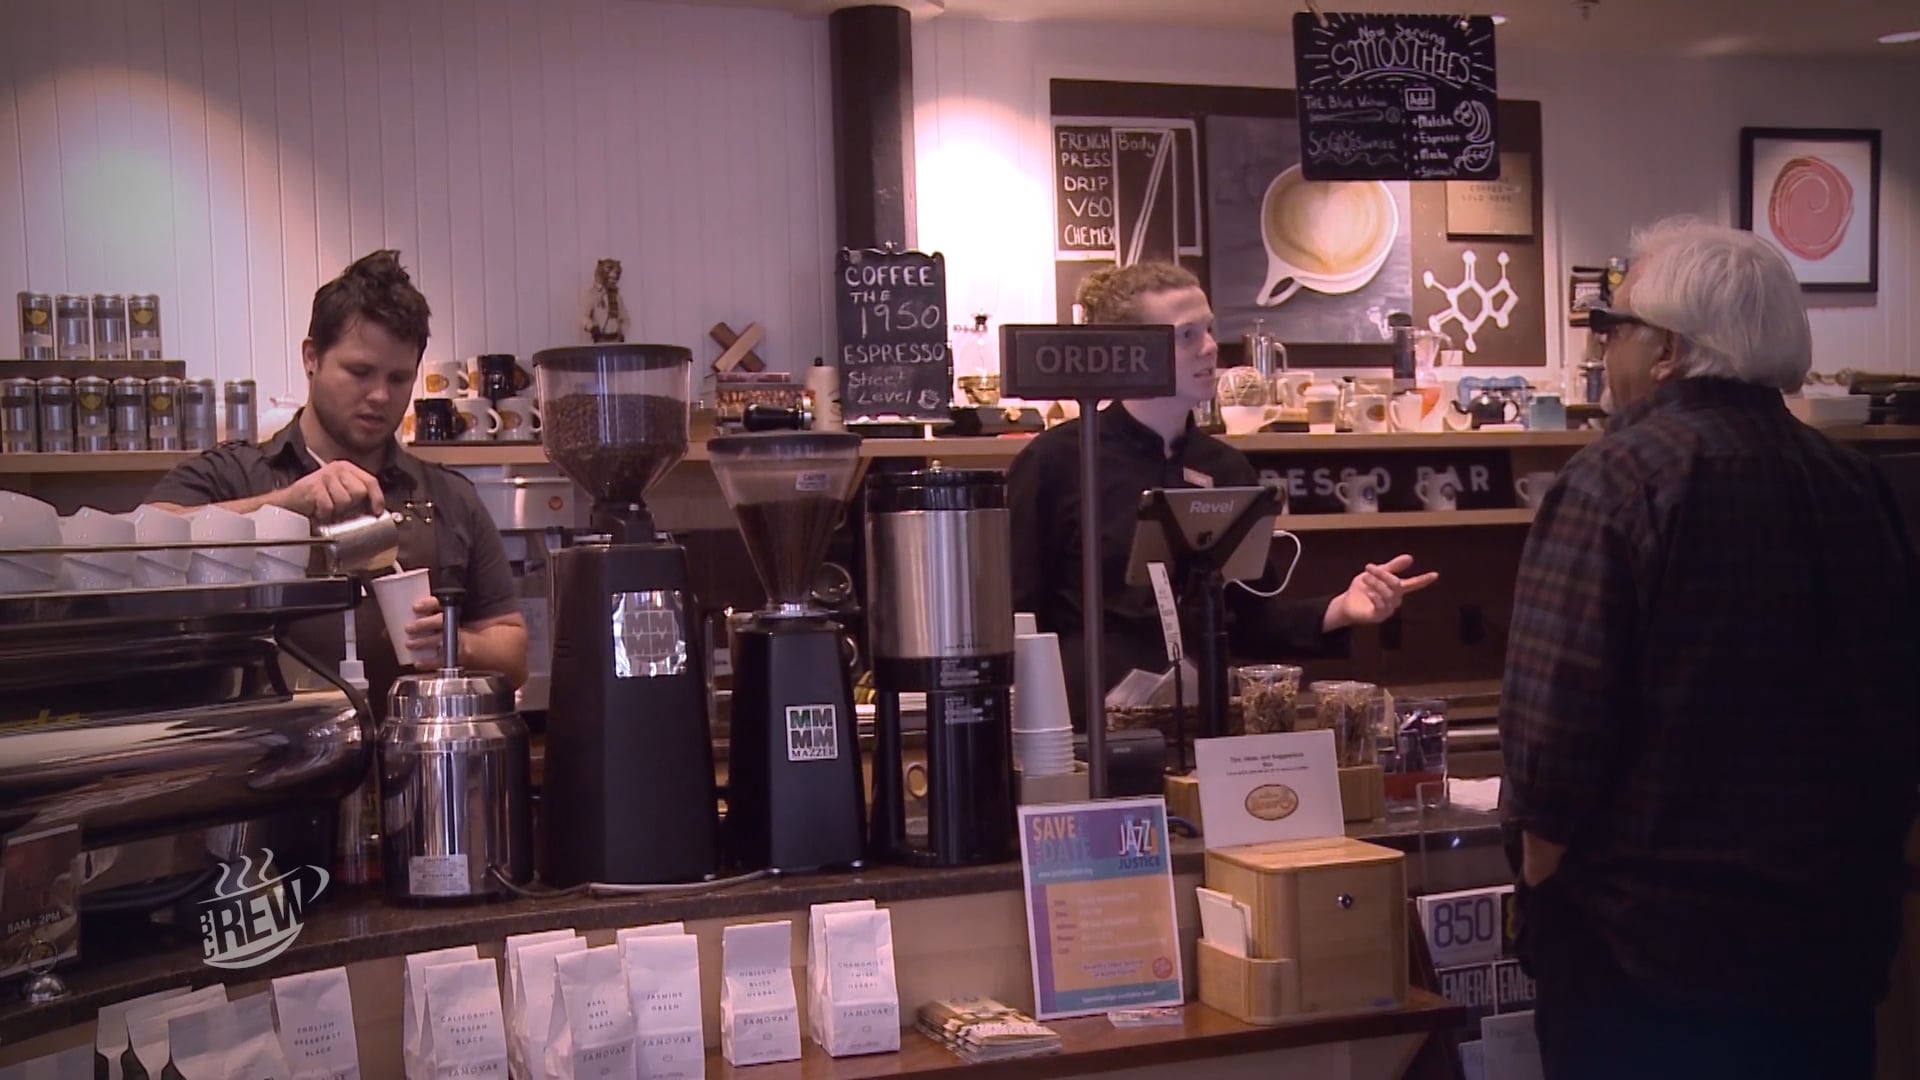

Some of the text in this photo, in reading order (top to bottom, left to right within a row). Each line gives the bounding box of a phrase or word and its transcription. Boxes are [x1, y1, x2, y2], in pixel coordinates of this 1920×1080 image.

[1358, 23, 1446, 48] Now Serving
[1331, 36, 1471, 83] SMOOTHIES
[1060, 131, 1111, 150] FRENCH
[1117, 134, 1157, 158] Body
[1061, 152, 1112, 167] PRESS
[1064, 176, 1109, 191] DRIP
[1067, 197, 1113, 218] V60
[1064, 224, 1114, 246] CHEMEX
[845, 265, 935, 287] COFFEE
[849, 290, 892, 303] THE
[861, 302, 941, 340] 1950
[843, 343, 945, 364] ESPRESSO
[1035, 345, 1149, 374] ORDER
[1190, 500, 1234, 513] Revel
[791, 748, 836, 758] MAZZER
[1032, 815, 1077, 841] SAVE
[1119, 819, 1152, 857] JAZZ
[1119, 857, 1160, 870] JUSTICE
[1434, 898, 1494, 948] 850
